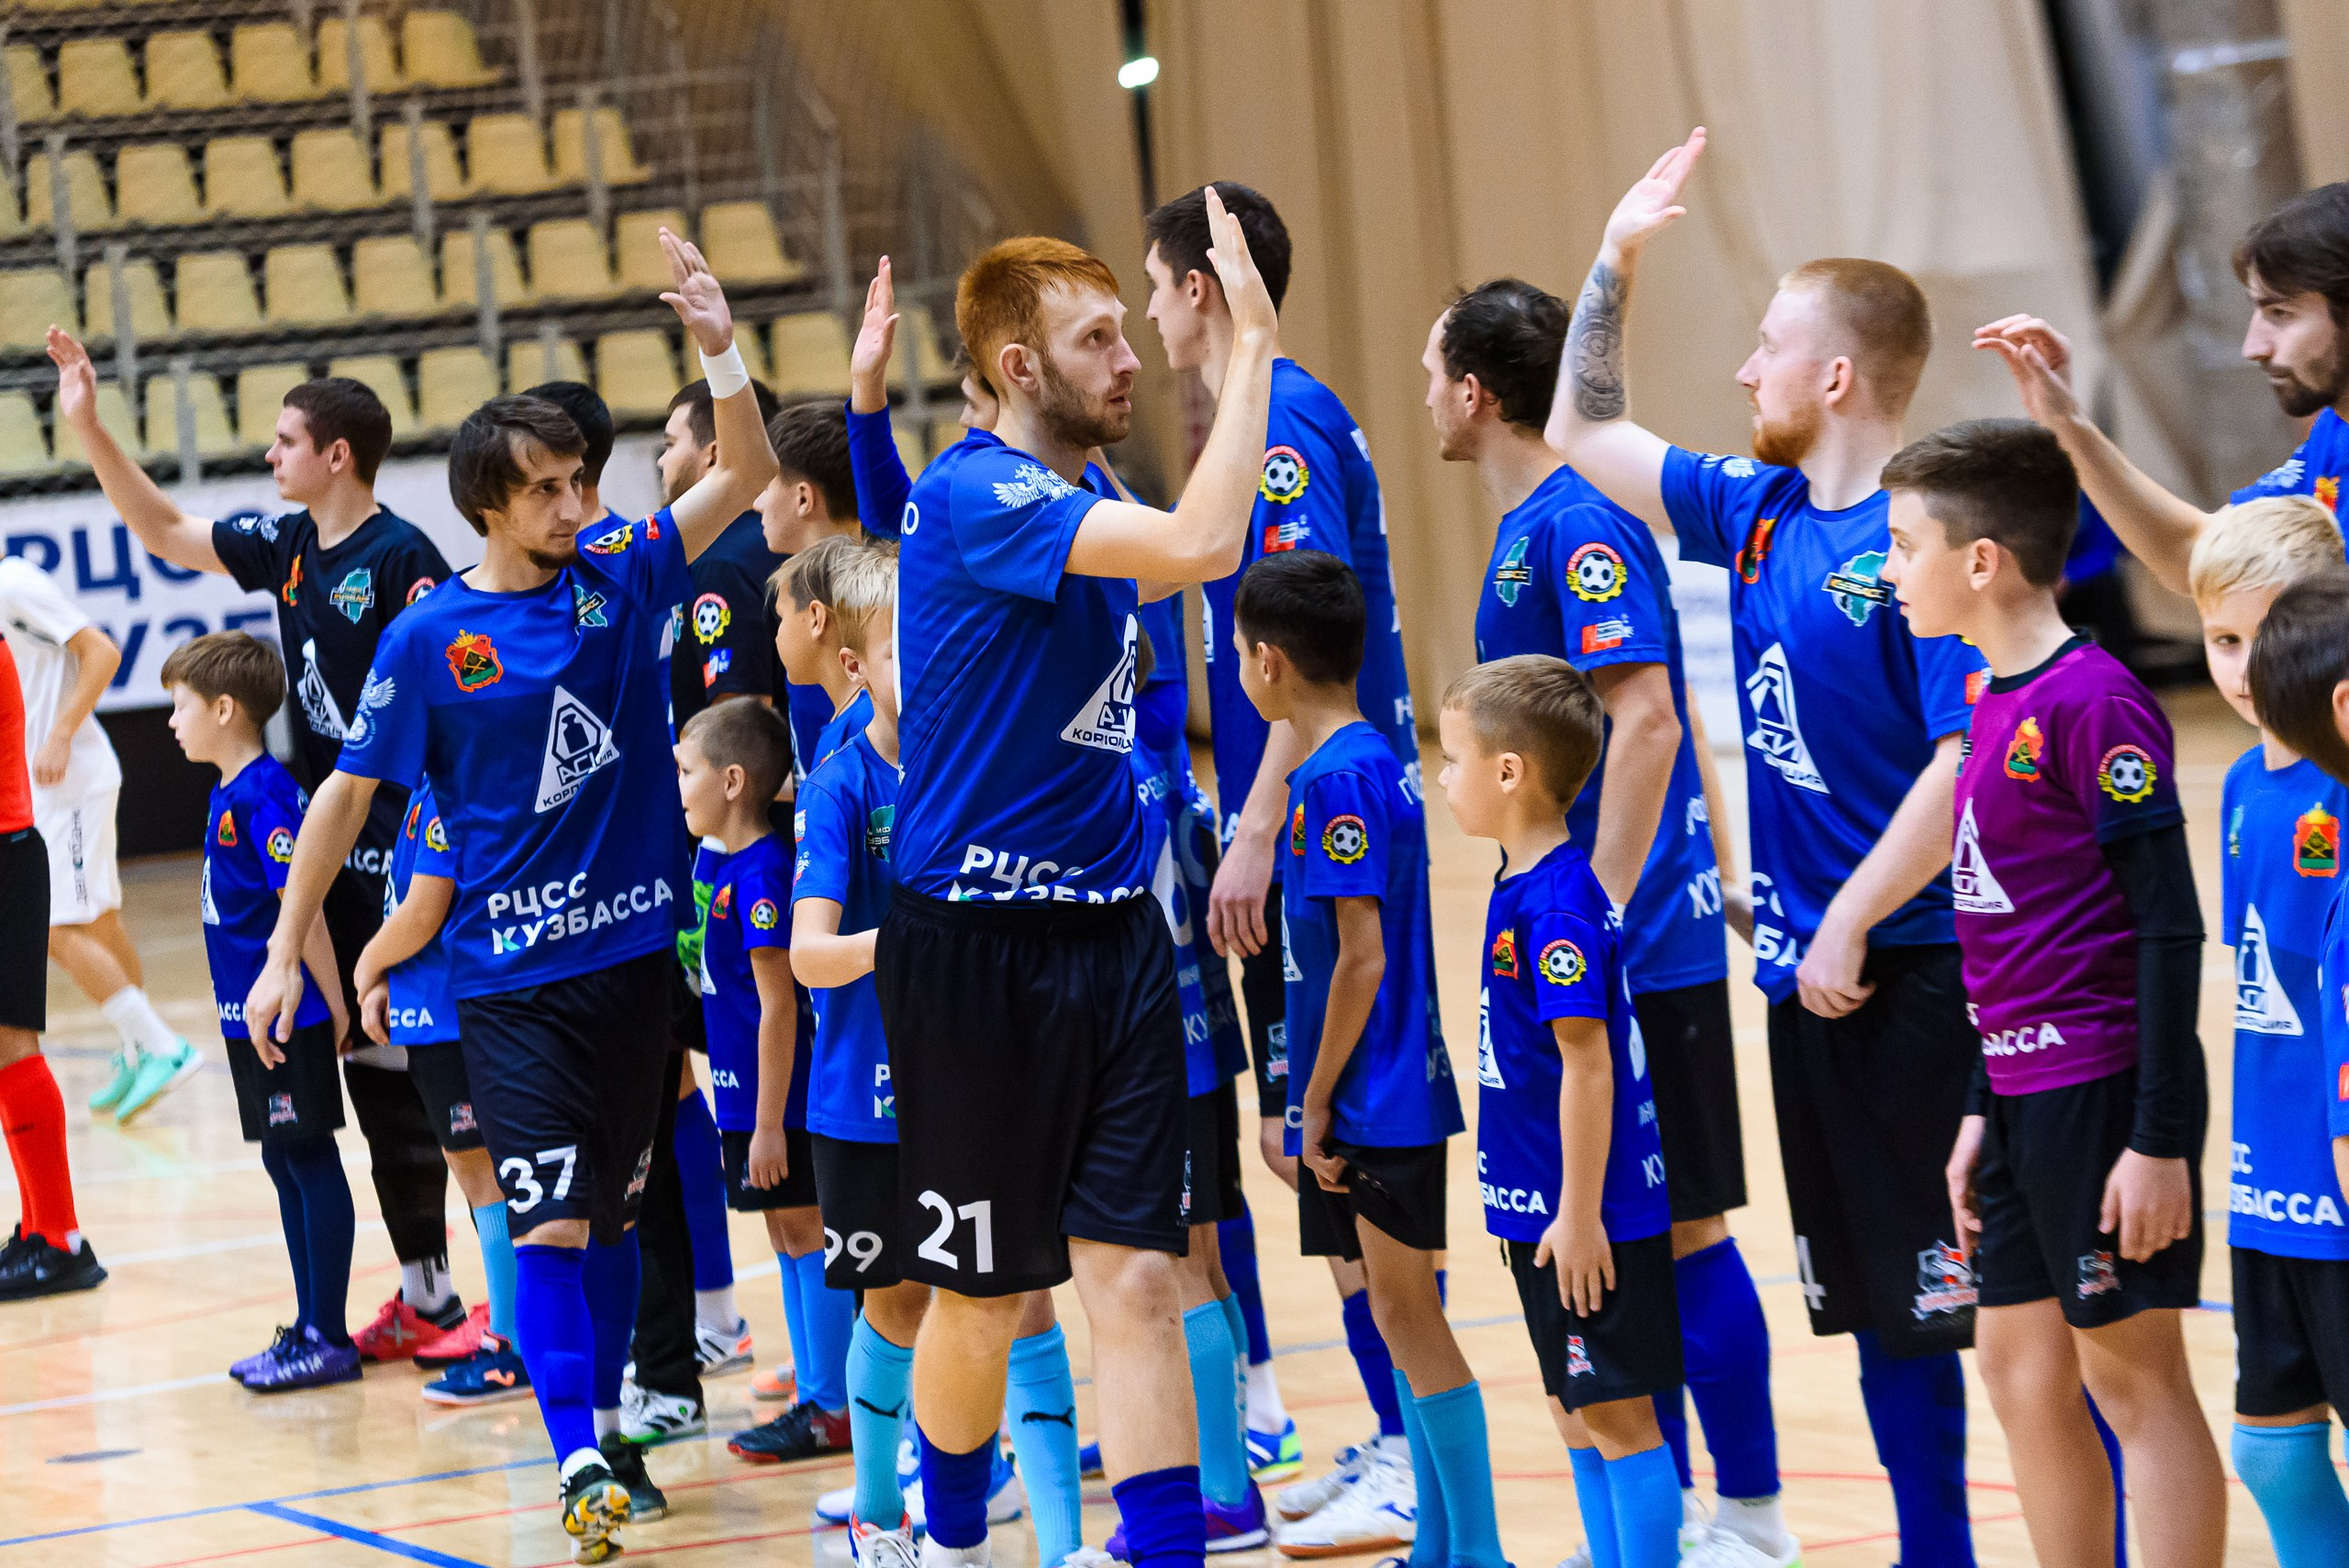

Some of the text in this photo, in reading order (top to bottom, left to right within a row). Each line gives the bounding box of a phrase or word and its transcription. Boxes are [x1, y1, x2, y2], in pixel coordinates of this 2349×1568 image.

[487, 871, 587, 919] РЦСС
[491, 877, 674, 955] КУЗБАССА
[499, 1144, 577, 1215] 37
[918, 1189, 994, 1273] 21
